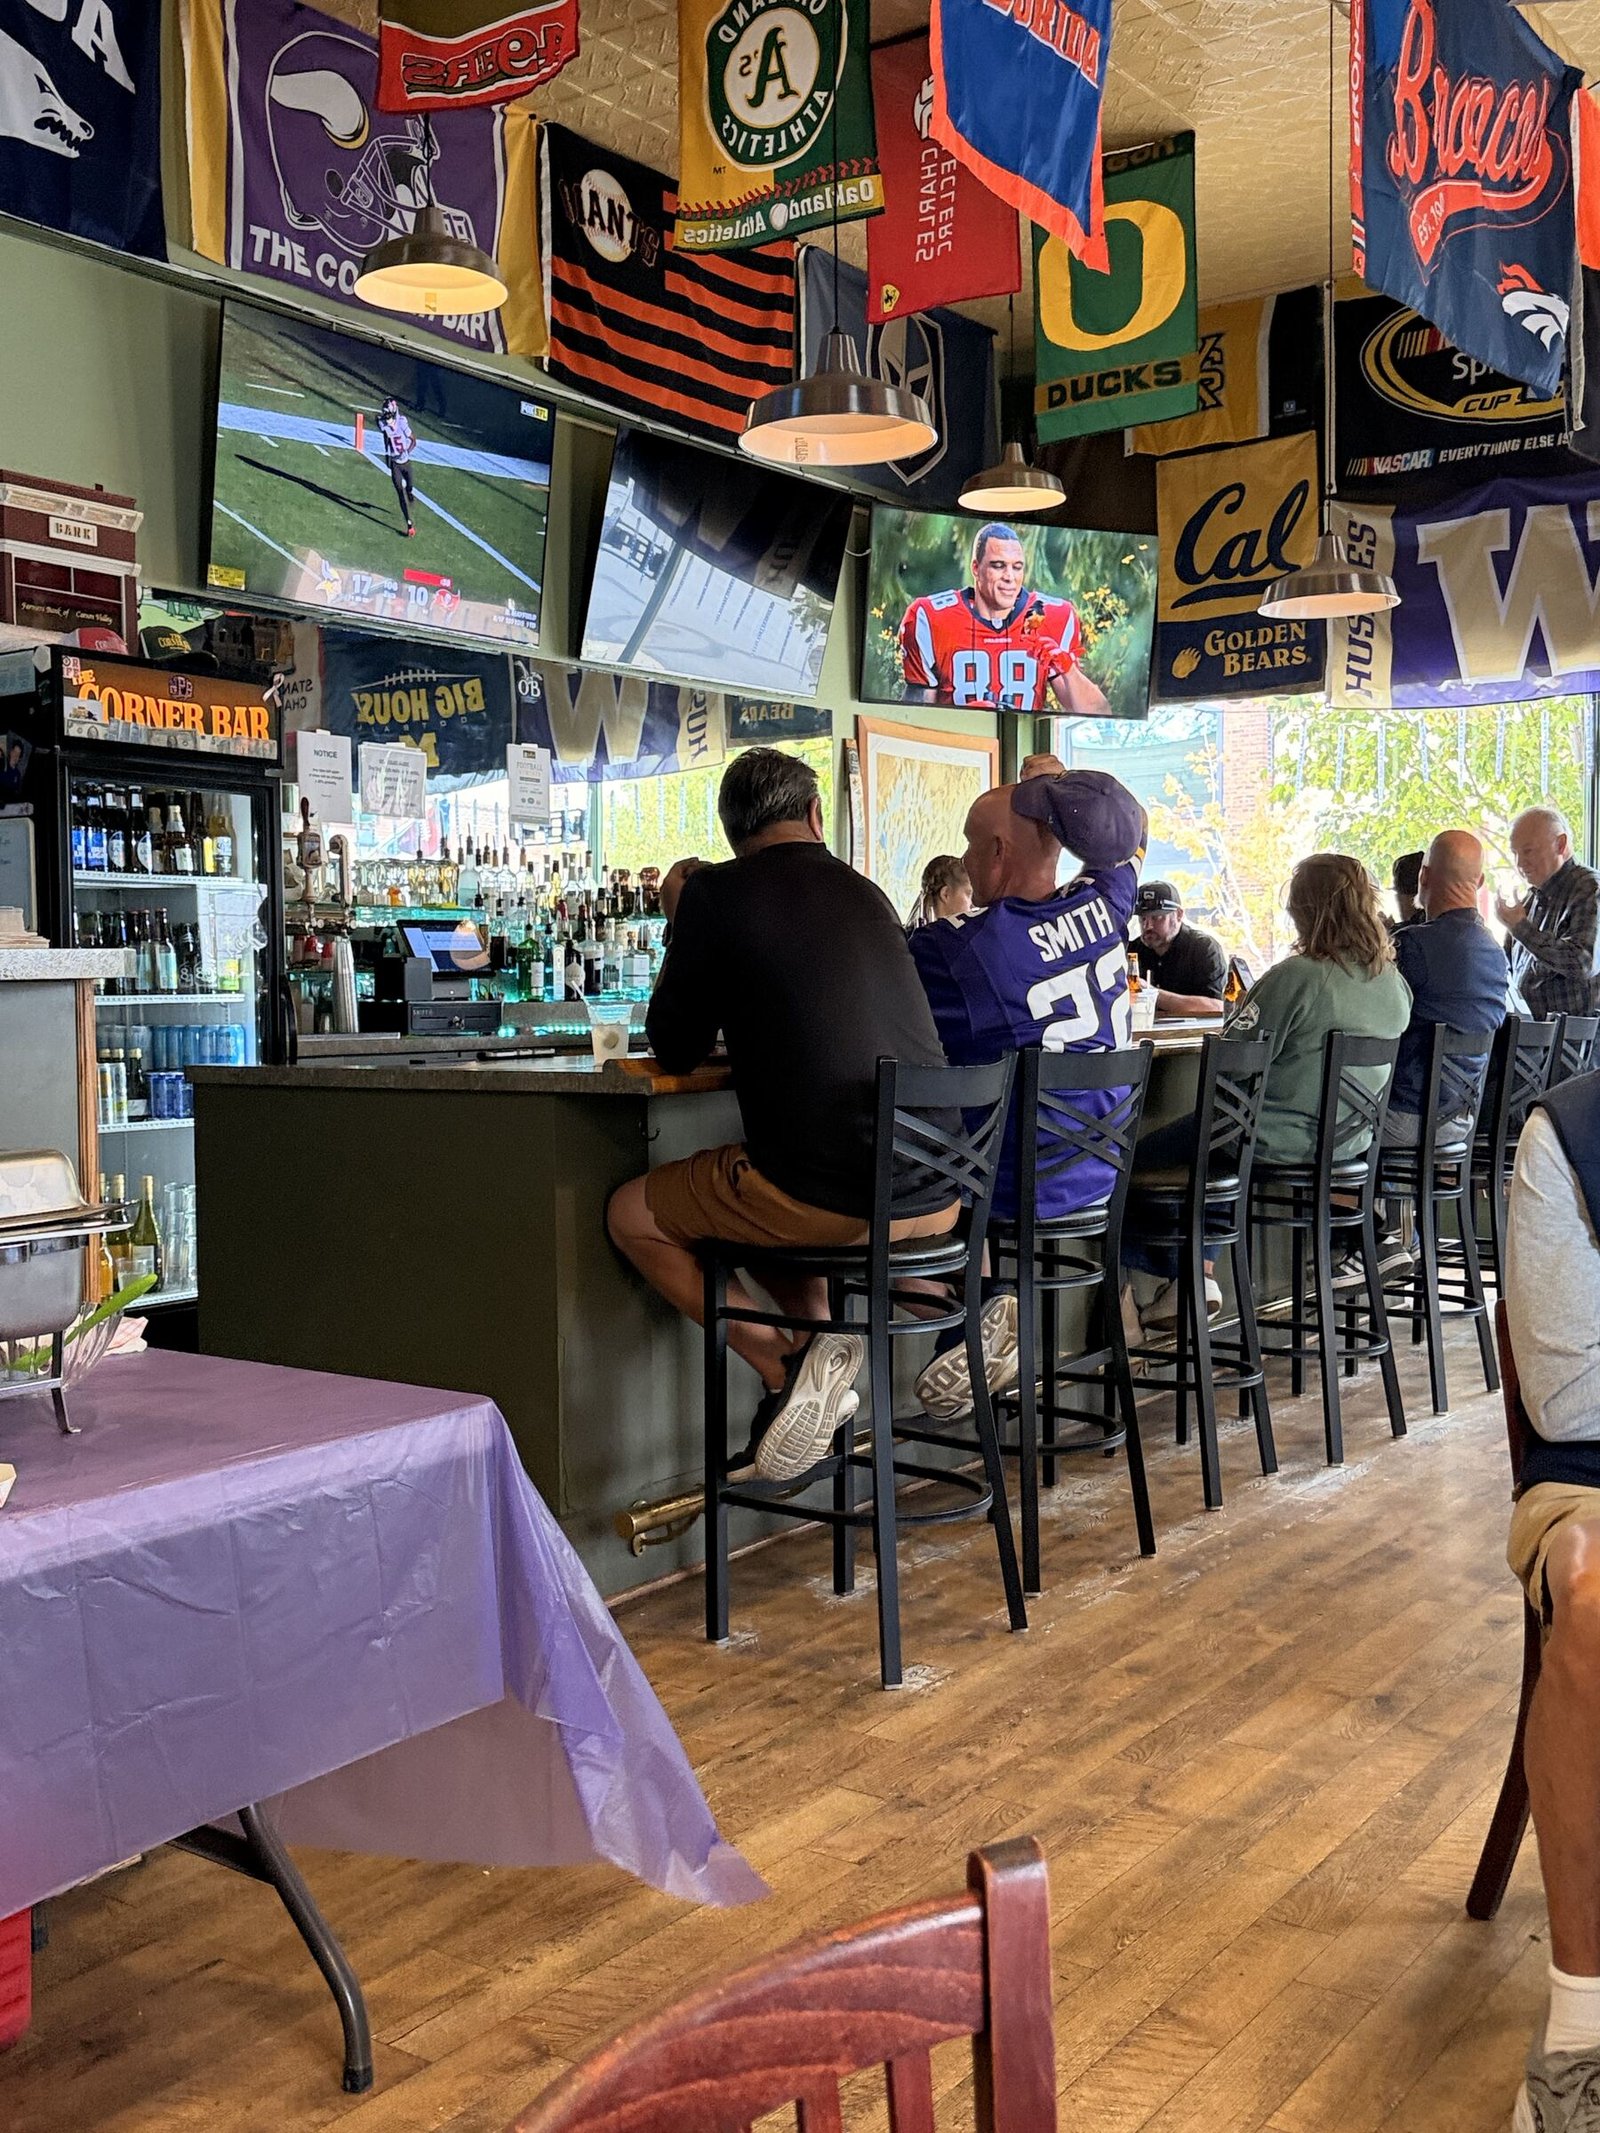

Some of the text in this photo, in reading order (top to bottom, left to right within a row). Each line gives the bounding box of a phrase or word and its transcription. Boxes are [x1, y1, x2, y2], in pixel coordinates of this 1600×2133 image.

[250, 224, 312, 278] THE
[1047, 361, 1182, 409] DUCKS
[1462, 393, 1512, 413] CUP
[1372, 447, 1435, 475] NASCAR
[1438, 438, 1521, 464] EVERYTHING
[1523, 434, 1555, 451] ELSE
[54, 521, 92, 541] BANK
[1174, 479, 1310, 586] Cal
[353, 575, 372, 595] 17
[408, 585, 428, 606] 10
[1345, 519, 1378, 699] HUSES
[1416, 501, 1600, 686] W
[1204, 619, 1306, 657] GOLDEN
[1223, 645, 1311, 678] BEARS
[952, 650, 1038, 712] 88
[78, 683, 270, 740] CORNER BAR
[313, 749, 338, 759] NOTICE
[1028, 898, 1114, 963] SMITH
[1026, 942, 1132, 1053] 22
